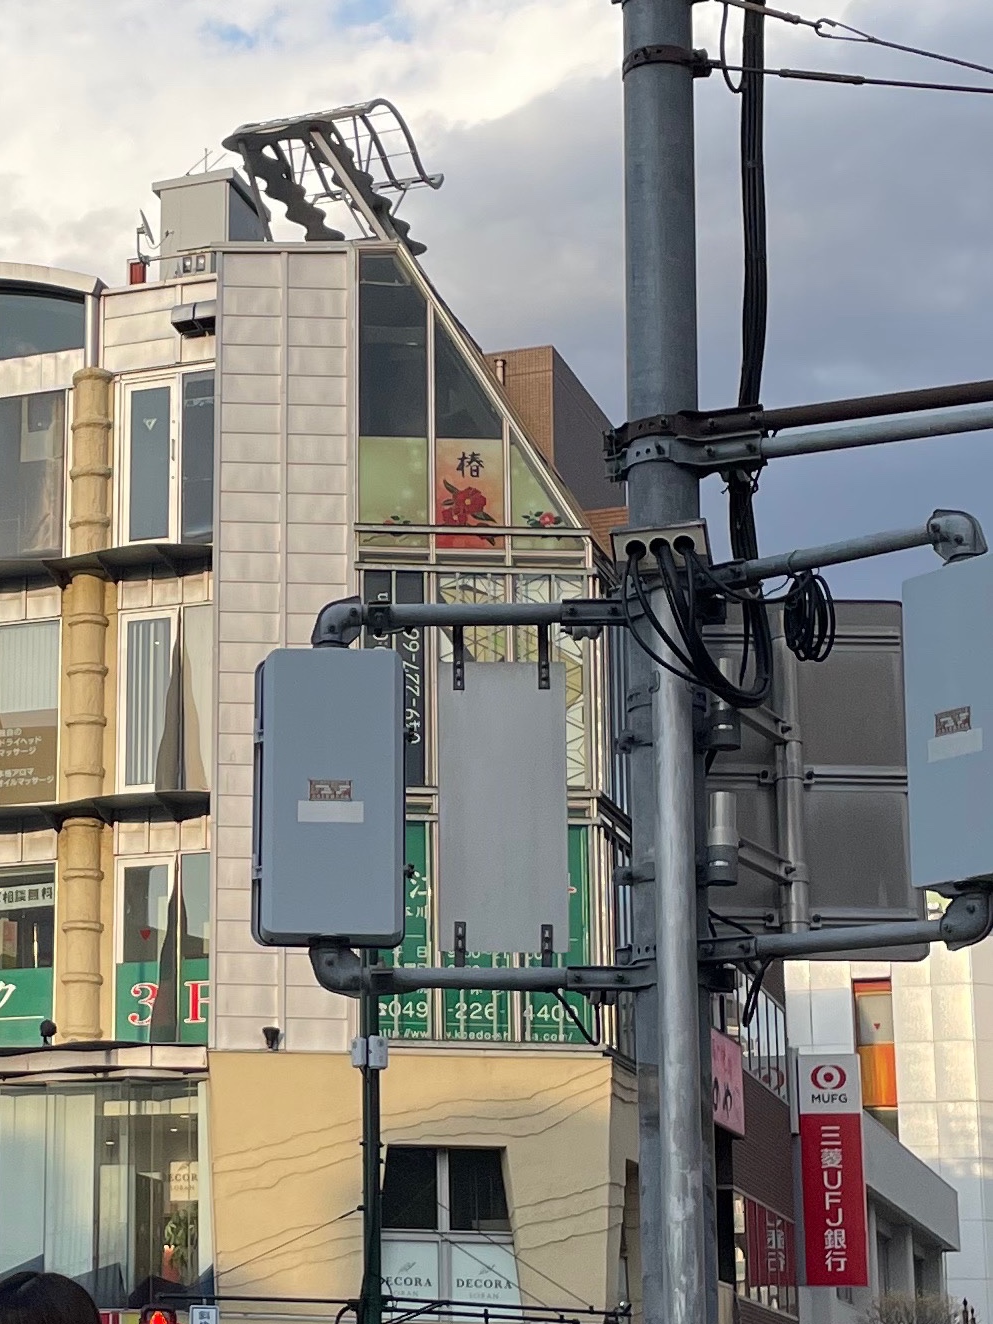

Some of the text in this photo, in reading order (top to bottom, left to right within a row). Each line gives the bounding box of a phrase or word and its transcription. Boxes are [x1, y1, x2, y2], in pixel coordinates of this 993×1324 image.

[456, 451, 485, 478] 椿
[811, 1093, 848, 1104] MUFG
[820, 1125, 848, 1272] 三菱UFJ銀行
[456, 1278, 513, 1289] DECORA
